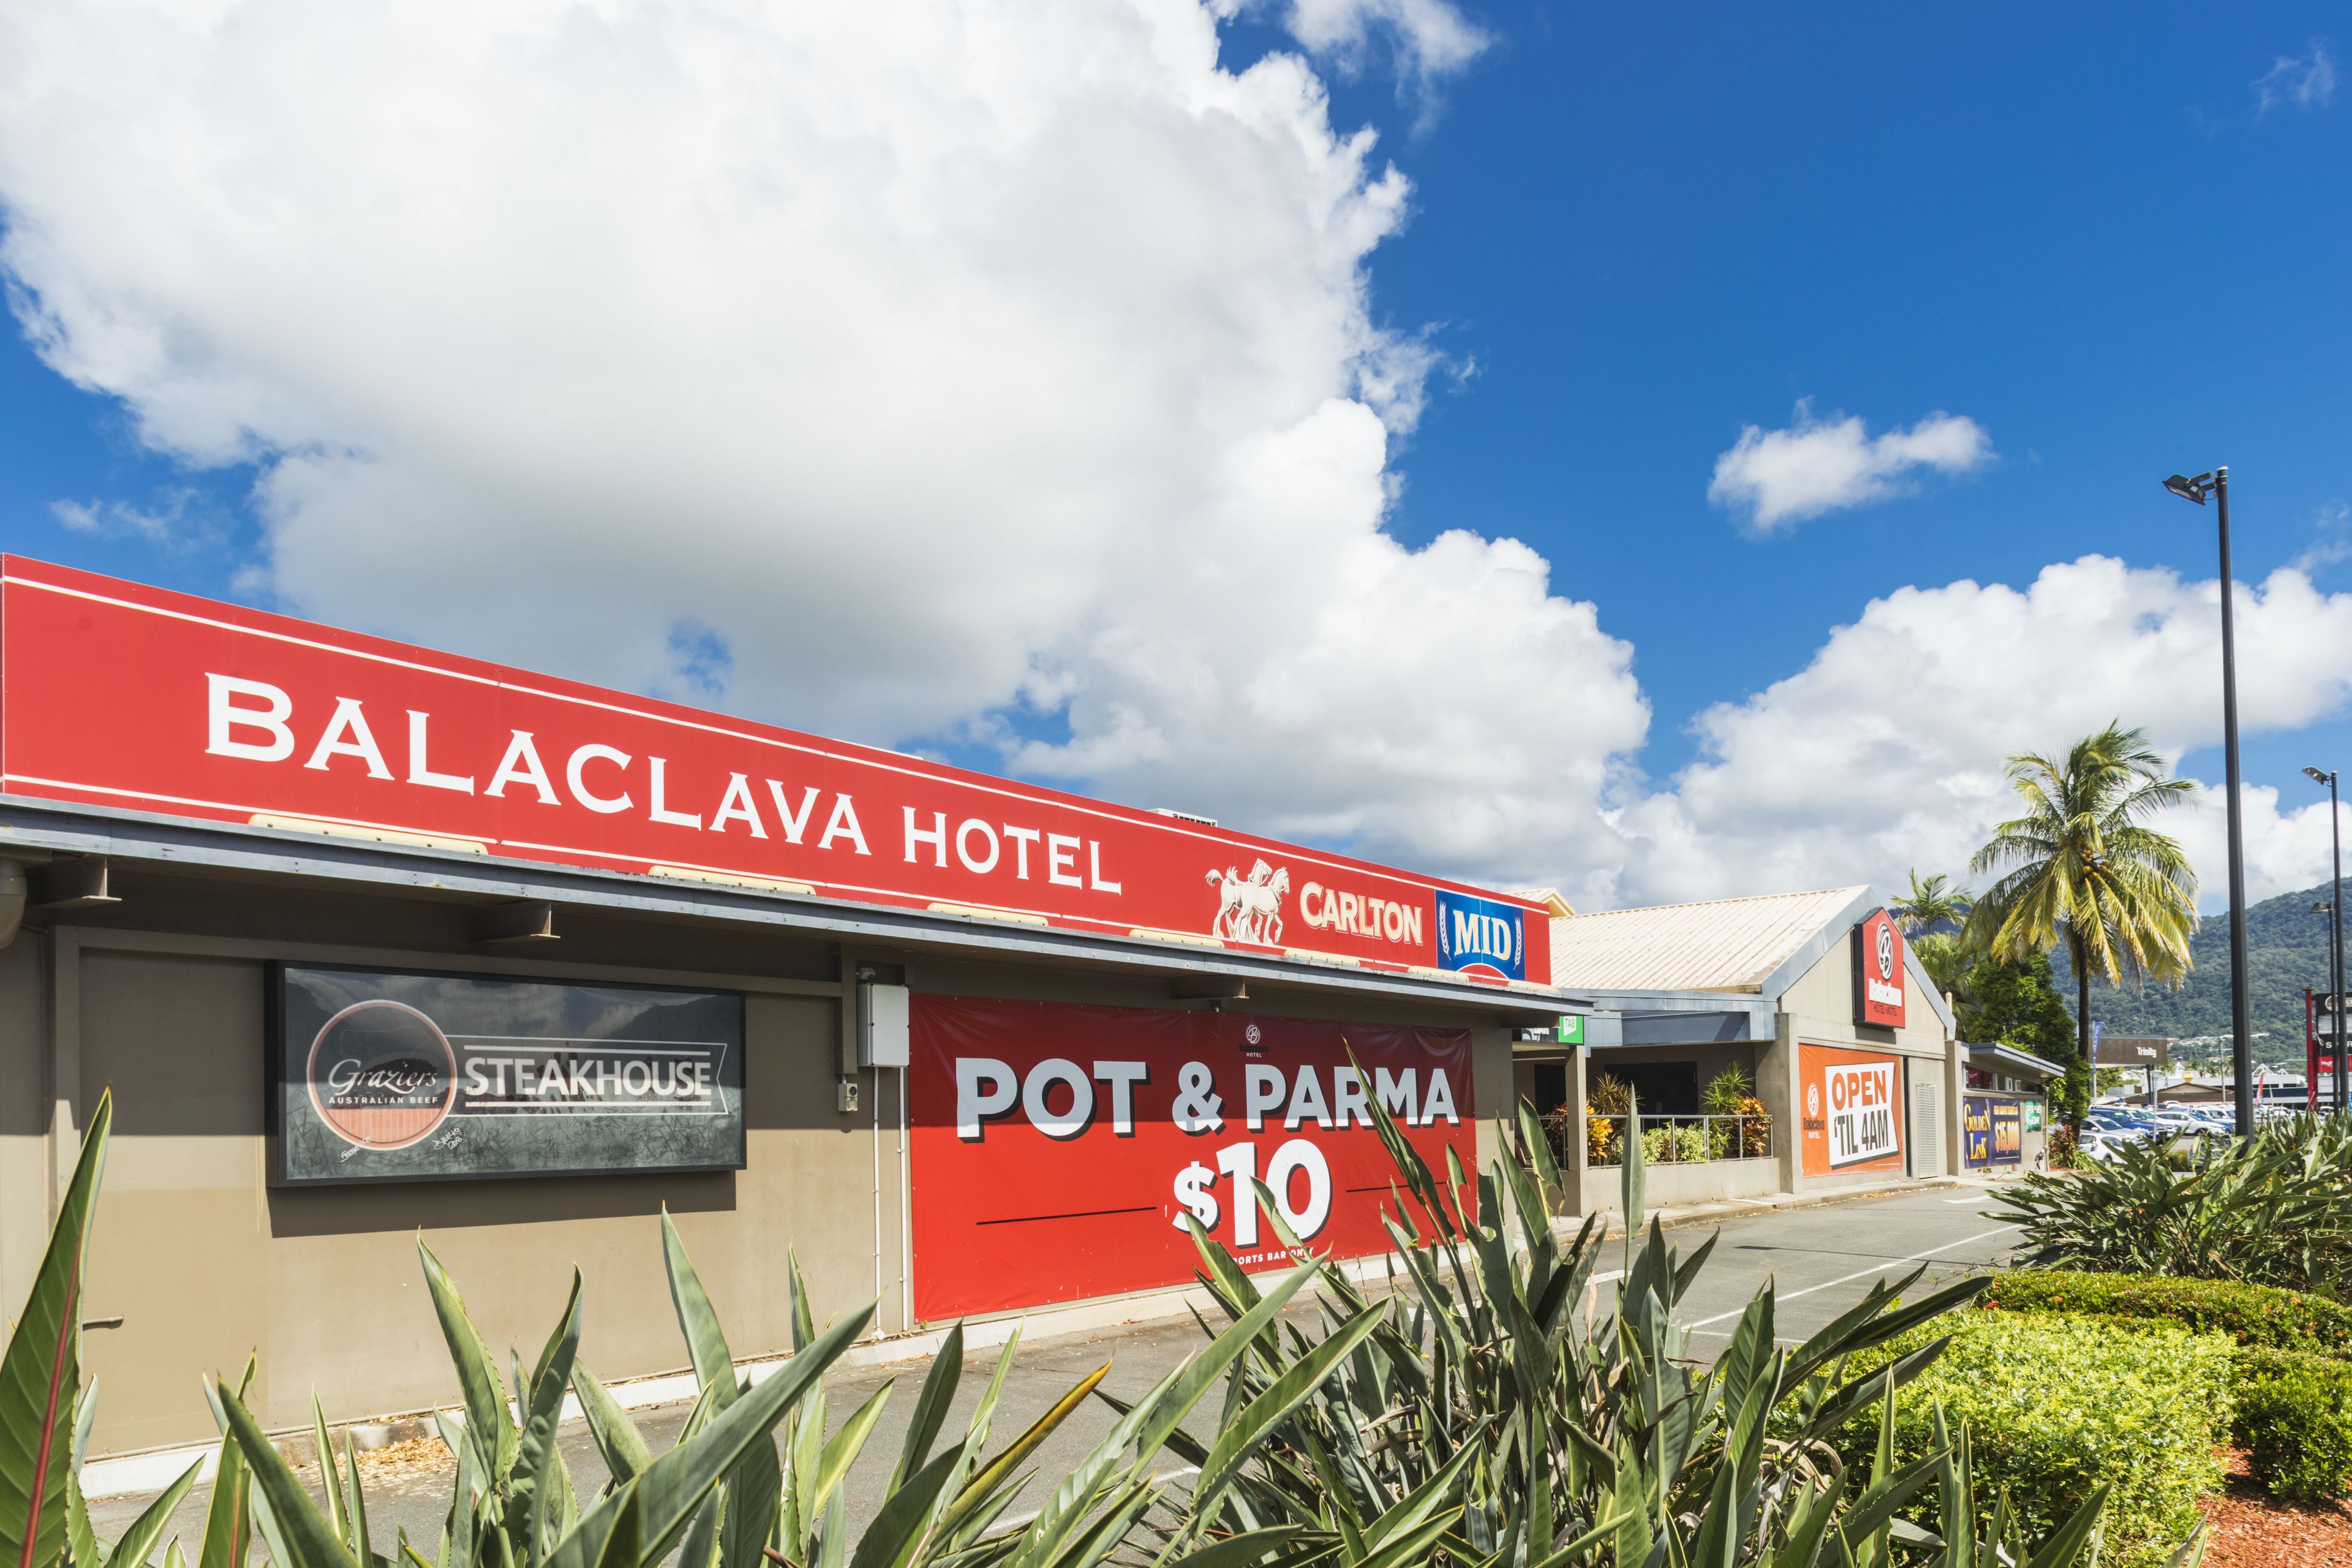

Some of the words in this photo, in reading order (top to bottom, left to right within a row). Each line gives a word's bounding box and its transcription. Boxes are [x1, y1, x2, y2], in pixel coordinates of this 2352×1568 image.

[205, 672, 872, 856] BALACLAVA
[902, 806, 1121, 895] HOTEL
[1300, 881, 1423, 946] CARLTON
[1453, 910, 1512, 961] MID
[1565, 1018, 1575, 1028] TAB
[2136, 1047, 2157, 1058] Trinity
[328, 1058, 437, 1095] Graziers
[464, 1057, 712, 1096] STEAKHOUSE
[1831, 1071, 1887, 1110] OPEN
[956, 1058, 1148, 1142] POT
[1172, 1061, 1224, 1134] &
[1245, 1064, 1460, 1132] PARMA
[1964, 1104, 1991, 1131] GOLDEN
[1861, 1109, 1888, 1151] 4AM
[1969, 1133, 1987, 1159] LINK
[1173, 1139, 1330, 1247] $10
[1232, 1254, 1264, 1265] PORTS
[1267, 1251, 1286, 1261] BAR
[1291, 1247, 1313, 1257] ONY
